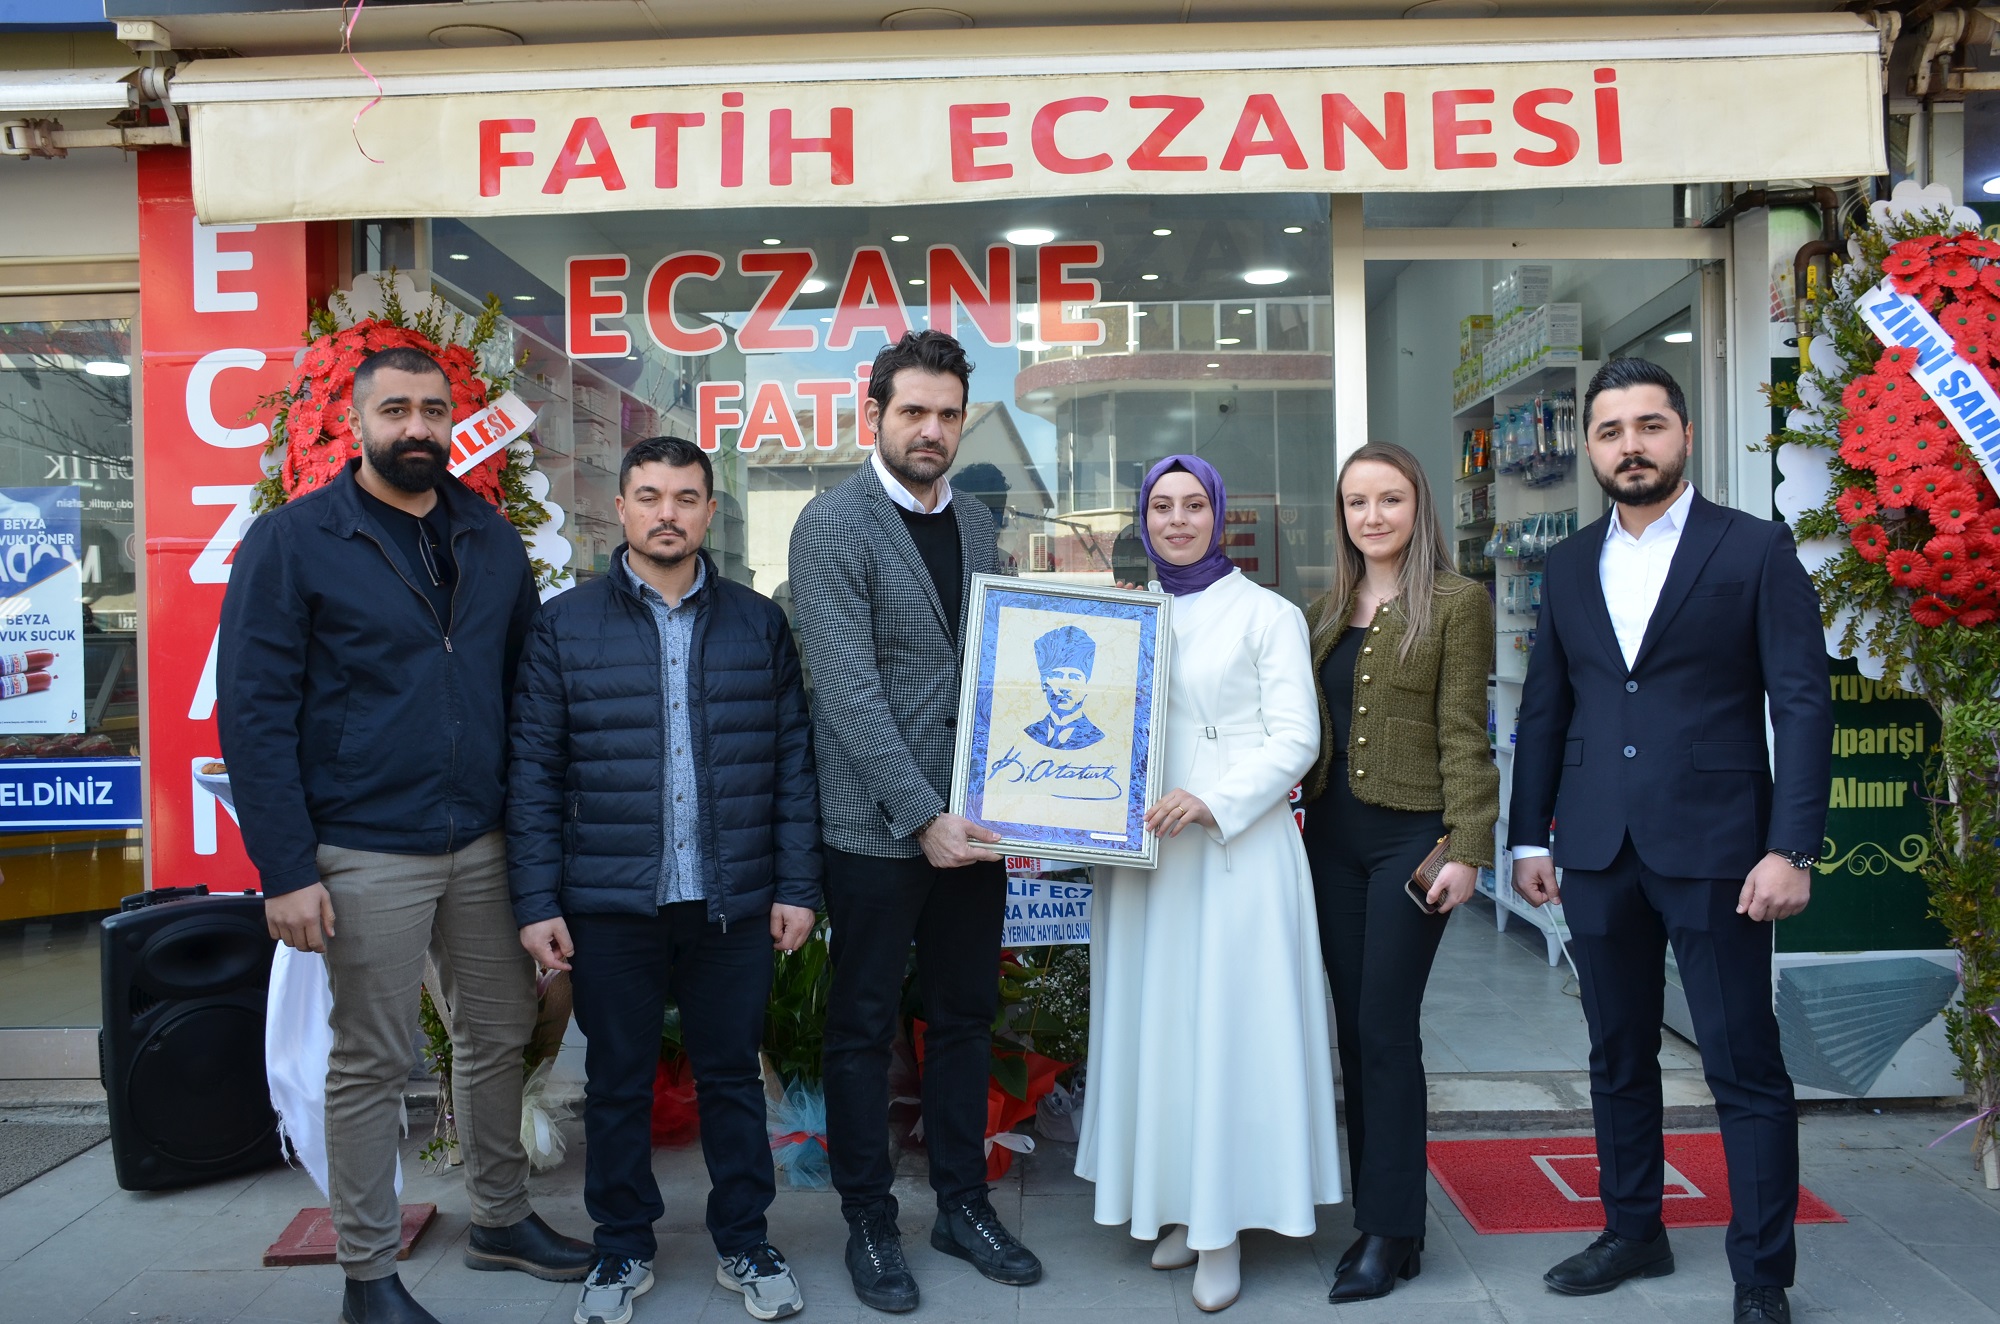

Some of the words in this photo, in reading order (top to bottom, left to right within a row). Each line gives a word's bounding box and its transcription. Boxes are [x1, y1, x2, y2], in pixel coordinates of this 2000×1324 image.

[479, 92, 854, 197] FATİH
[948, 68, 1624, 183] ECZANESİ
[565, 240, 1105, 359] ECZANE
[1869, 292, 1957, 375] ZİHNİ
[3, 518, 47, 530] BEYZA
[27, 531, 75, 545] DÖNER
[6, 614, 50, 625] BEYZA
[30, 630, 76, 641] SUCUK
[0, 775, 114, 806] ELDİNİZ
[1829, 777, 1908, 808] Alınır
[1028, 902, 1087, 919] KANAT
[1008, 922, 1036, 943] YERİNİZ
[1037, 923, 1065, 942] HAYIRLI
[1067, 922, 1090, 940] OLSUN
